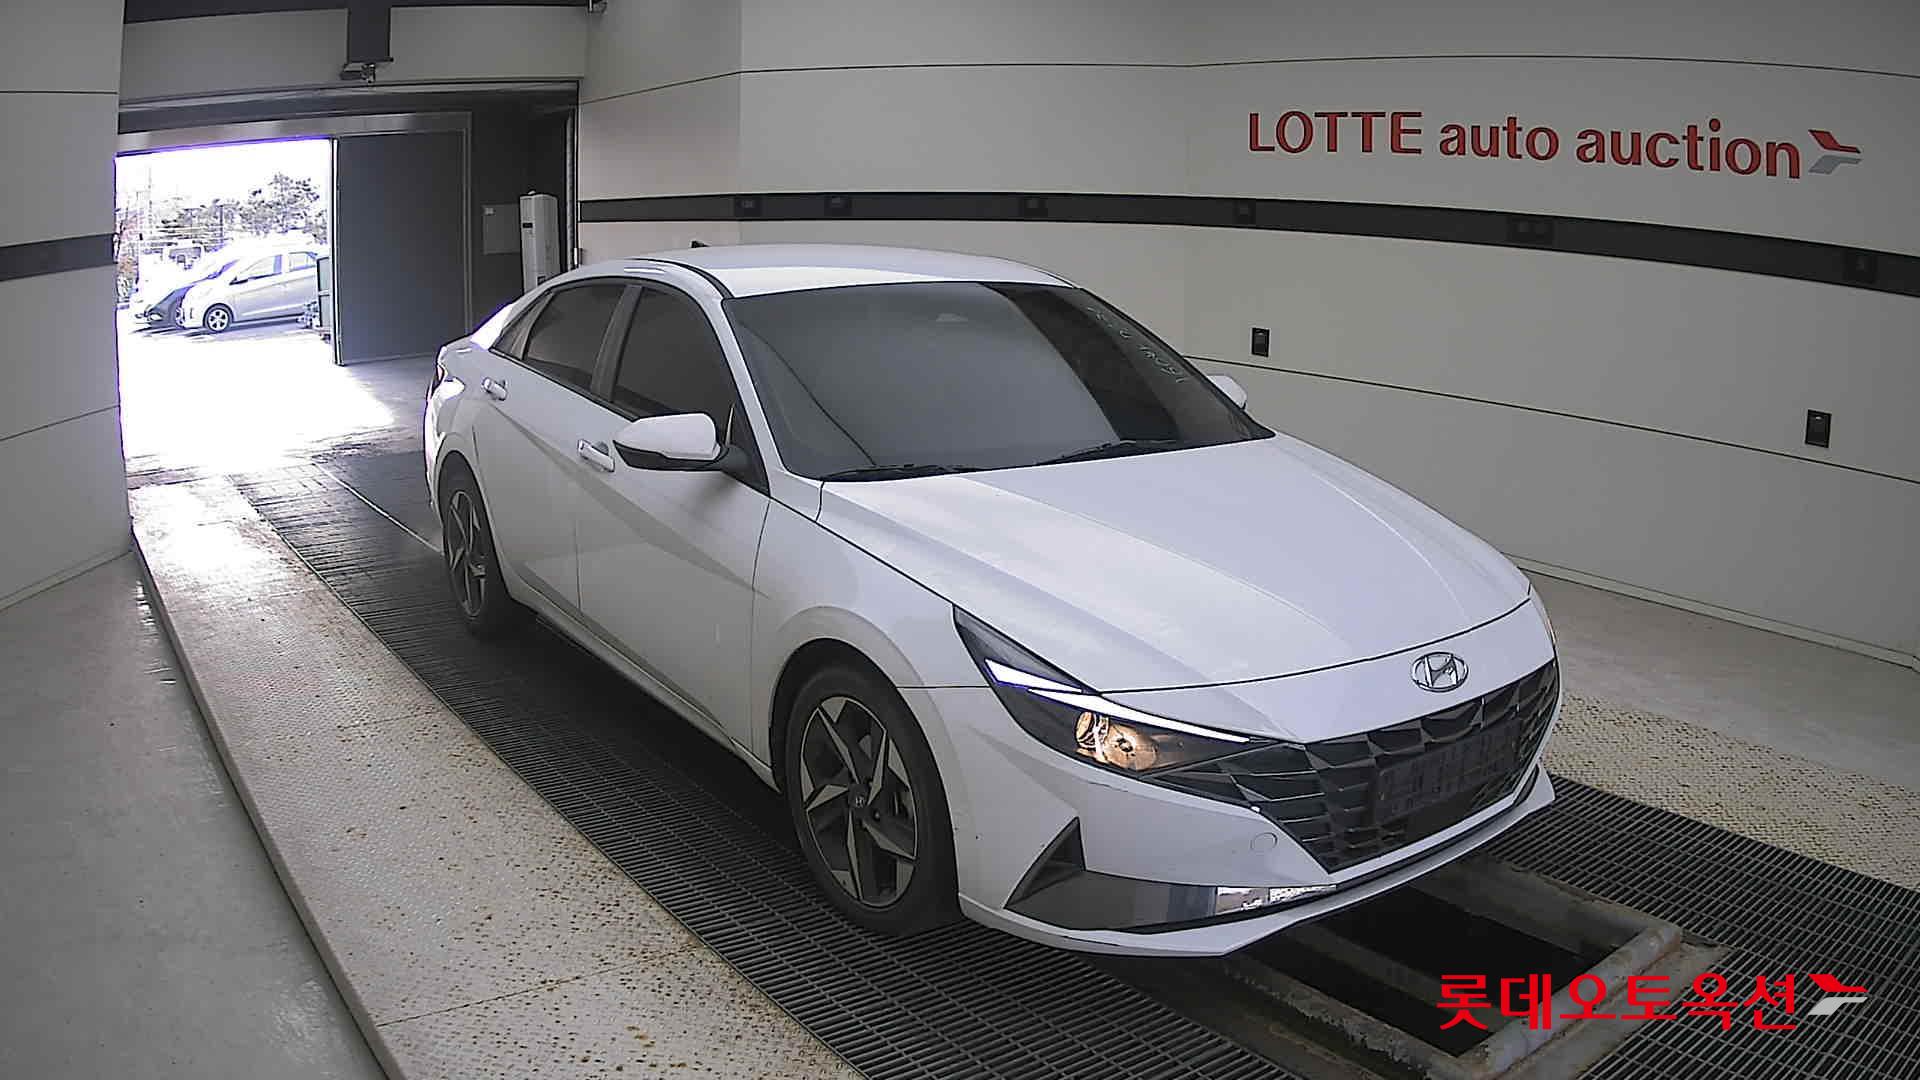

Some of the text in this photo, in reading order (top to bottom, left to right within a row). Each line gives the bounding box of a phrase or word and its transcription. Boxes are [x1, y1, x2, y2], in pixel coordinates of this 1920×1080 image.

[1249, 111, 1801, 179] LOTTE auto auction
